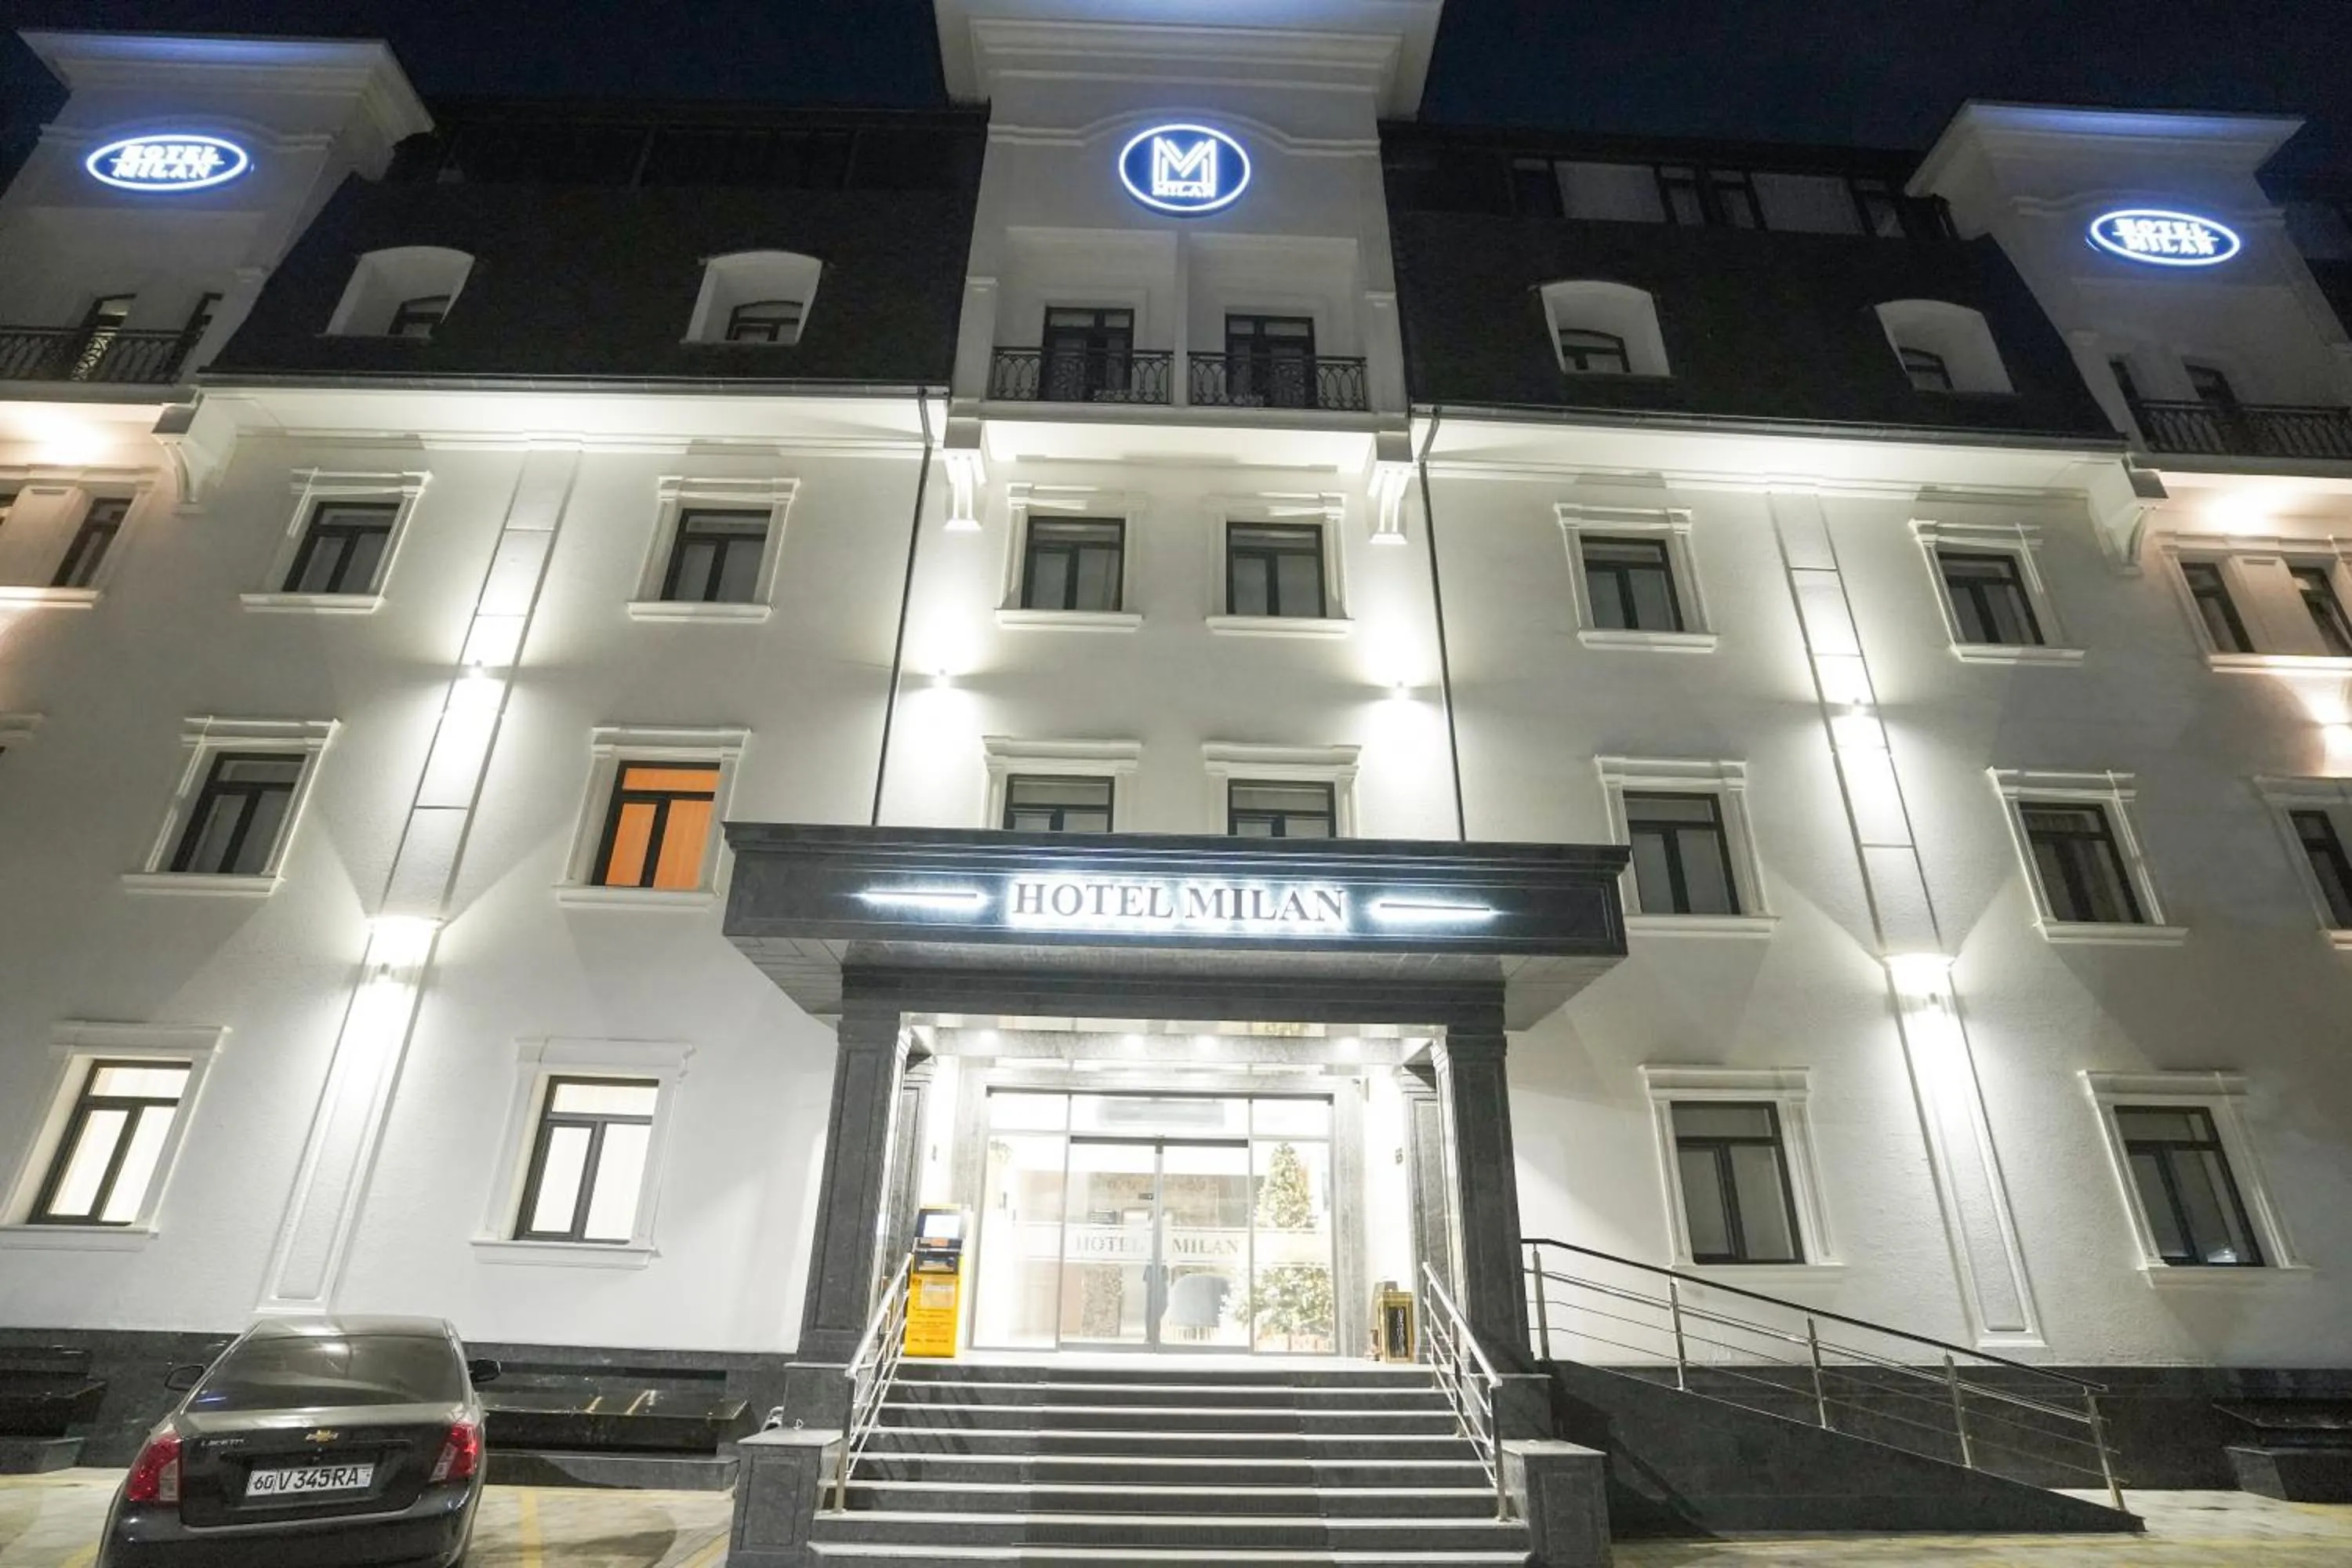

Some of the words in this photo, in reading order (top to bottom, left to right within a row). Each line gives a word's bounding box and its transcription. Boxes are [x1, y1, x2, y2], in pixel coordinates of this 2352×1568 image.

[122, 144, 218, 164] HOTEL
[112, 161, 212, 179] MILAN
[2114, 219, 2210, 239] HOTEL
[2122, 235, 2215, 255] MILAN
[1012, 883, 1174, 918] HOTEL
[1185, 887, 1345, 921] MILAN
[1076, 1236, 1145, 1253] HOTEL
[1172, 1238, 1240, 1254] MILAN
